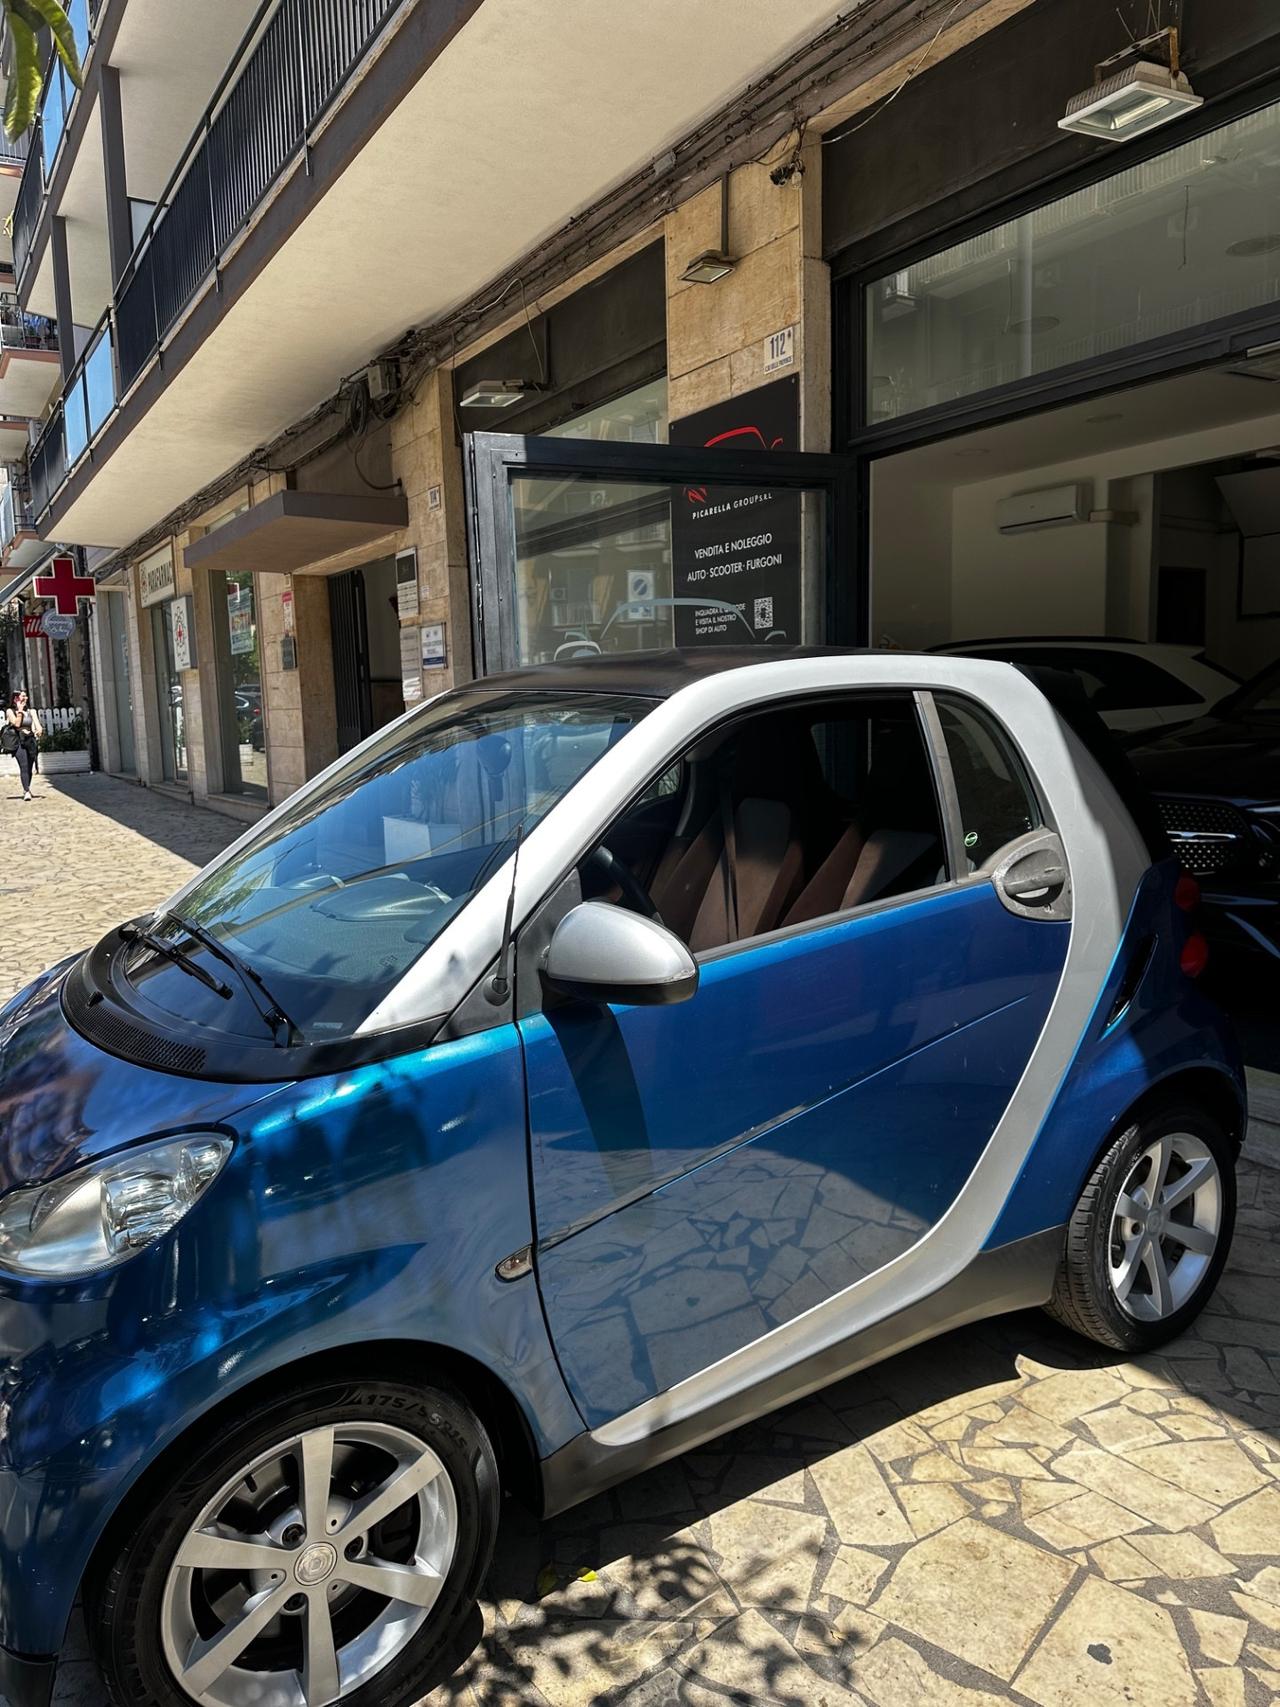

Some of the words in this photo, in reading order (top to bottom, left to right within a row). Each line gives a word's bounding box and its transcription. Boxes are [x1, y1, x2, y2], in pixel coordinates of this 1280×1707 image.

[770, 331, 786, 360] 112
[692, 502, 731, 520] PICARELLA
[694, 544, 724, 559] VENDITA
[725, 542, 730, 553] E
[731, 532, 773, 552] NOLEGGIO
[709, 561, 743, 578] SCOOTER
[746, 553, 783, 571] FURGONI
